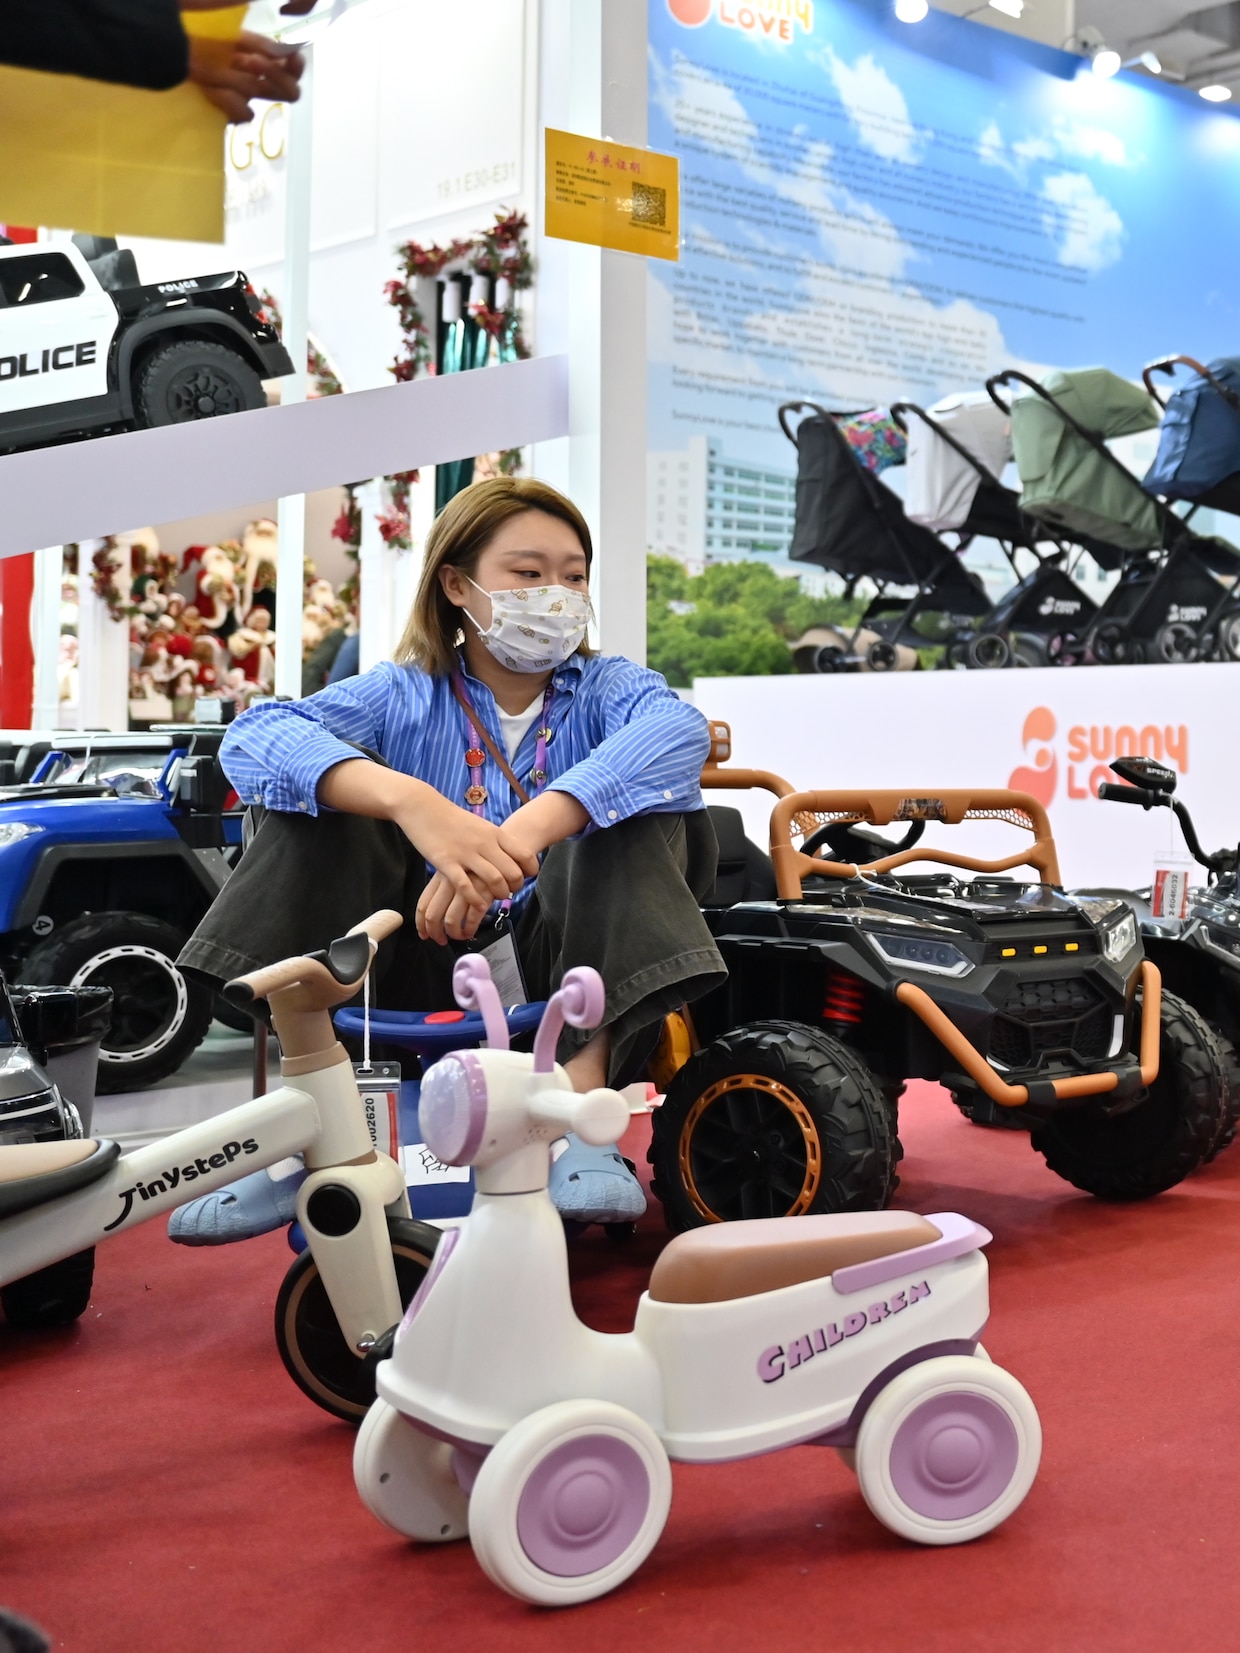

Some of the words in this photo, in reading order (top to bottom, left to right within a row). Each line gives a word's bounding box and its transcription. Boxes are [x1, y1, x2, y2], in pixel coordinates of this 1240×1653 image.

[719, 1, 790, 40] LOVE
[157, 280, 199, 294] POLICE
[0, 340, 97, 381] OLICE
[1068, 764, 1140, 800] LO
[757, 1280, 932, 1384] CHILDREN
